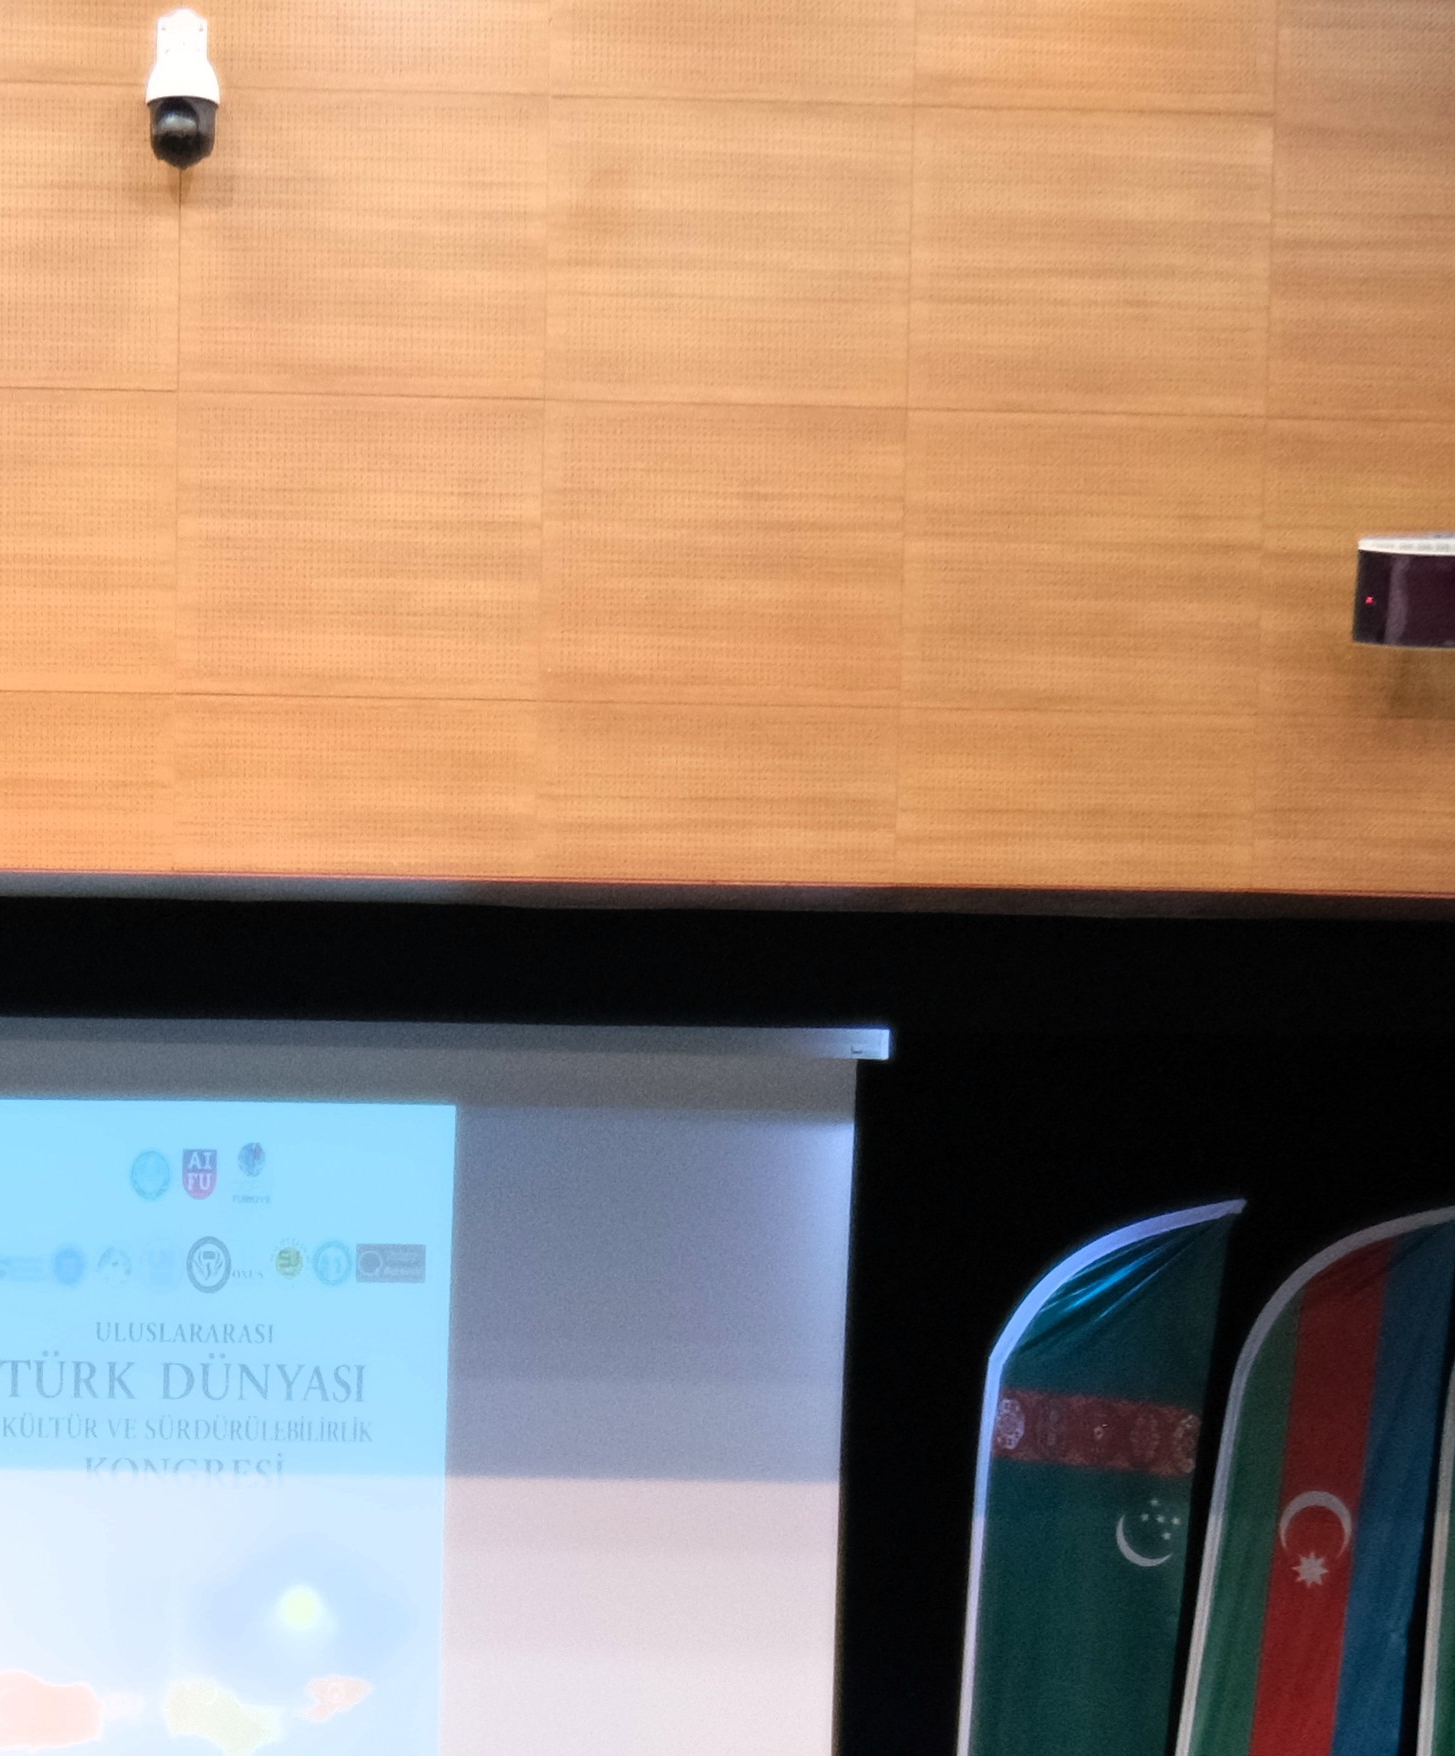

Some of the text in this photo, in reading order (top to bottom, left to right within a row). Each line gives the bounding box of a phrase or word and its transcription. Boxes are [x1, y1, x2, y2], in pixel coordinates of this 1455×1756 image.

[189, 1152, 212, 1169] AI
[187, 1173, 212, 1190] FU
[95, 1321, 274, 1345] ULUSLARARASI
[161, 1352, 366, 1403] DÜNYASI
[1, 1414, 373, 1443] KÜLTÜR VE SÜRDÜRÜLEBİLİRLİK
[84, 1454, 285, 1490] KONGRESİ
